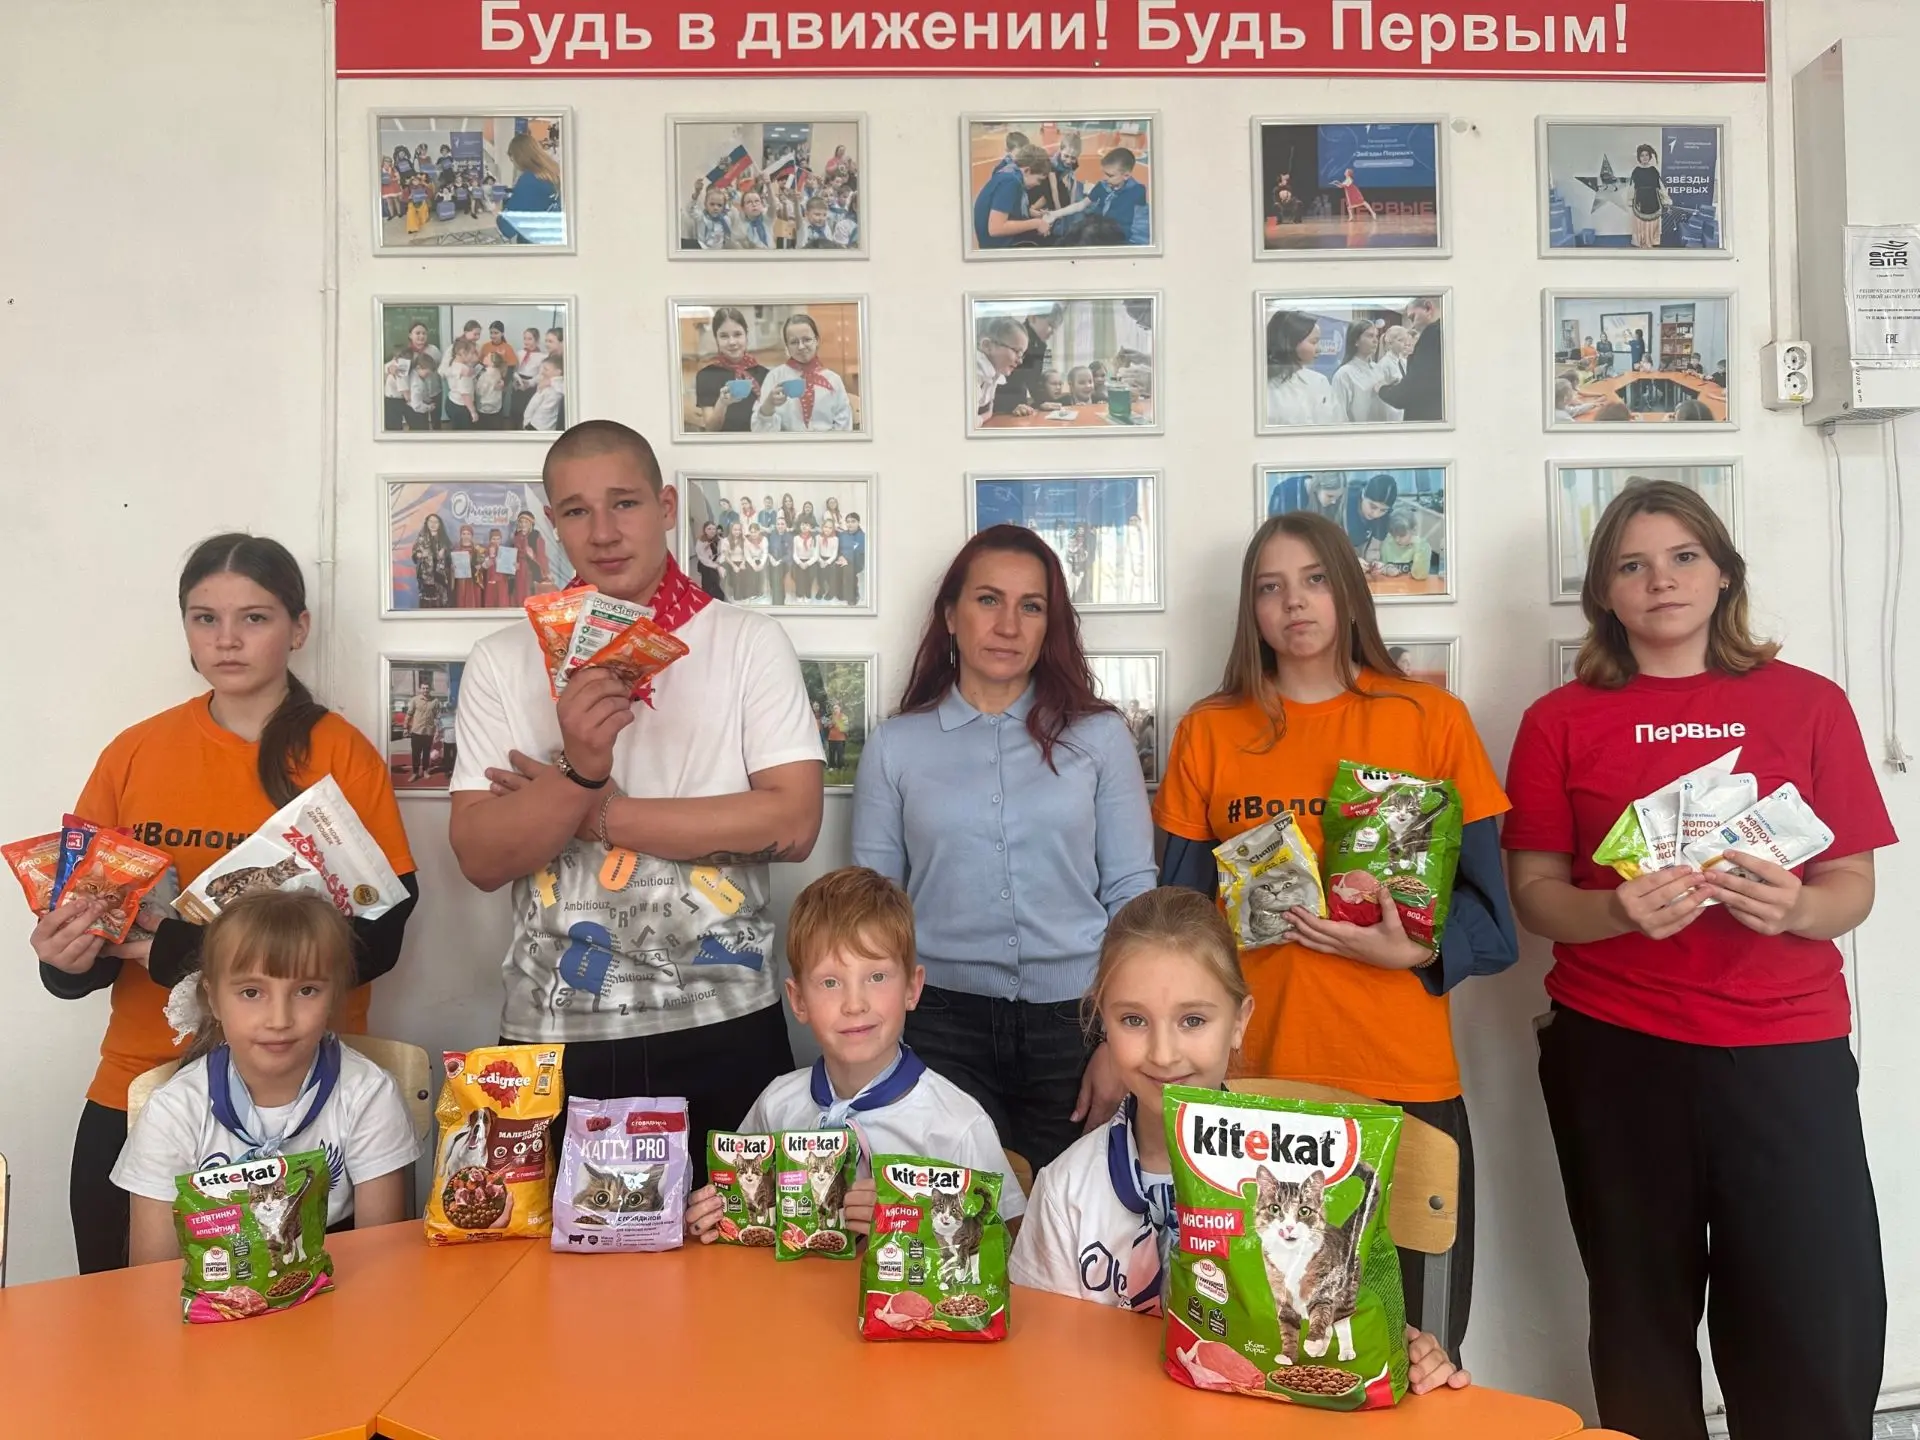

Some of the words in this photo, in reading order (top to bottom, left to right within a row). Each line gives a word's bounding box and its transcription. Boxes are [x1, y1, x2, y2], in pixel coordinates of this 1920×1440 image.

[481, 0, 652, 65] Будь
[679, 13, 716, 51] в
[737, 0, 1108, 59] движении!
[1138, 0, 1306, 64] Будь
[1332, 0, 1627, 64] Первым!
[1635, 722, 1746, 743] Первые
[1683, 820, 1720, 828] кошек
[1736, 820, 1759, 846] Корм
[1744, 814, 1772, 845] кошек
[133, 822, 254, 850] #Волон
[1653, 840, 1677, 852] шек
[96, 850, 117, 864] PRO
[1770, 844, 1791, 865] для
[564, 901, 610, 912] Ambitiouz
[662, 988, 717, 1009] Ambitiouz
[466, 1070, 531, 1090] Pedigree
[580, 1139, 630, 1160] KATTY
[636, 1138, 666, 1159] PRO
[718, 1137, 767, 1153] kitekat
[788, 1136, 840, 1151] kitekat
[1193, 1115, 1336, 1168] kitekat
[200, 1164, 277, 1187] kitekat
[891, 1166, 960, 1189] kitekat
[191, 1209, 238, 1225] ТЕЛЯТИНКА
[885, 1207, 919, 1218] МЯСНОЙ
[1182, 1212, 1235, 1230] МЯСНОЙ
[890, 1219, 907, 1230] ПИР
[1190, 1236, 1216, 1252] ПИР
